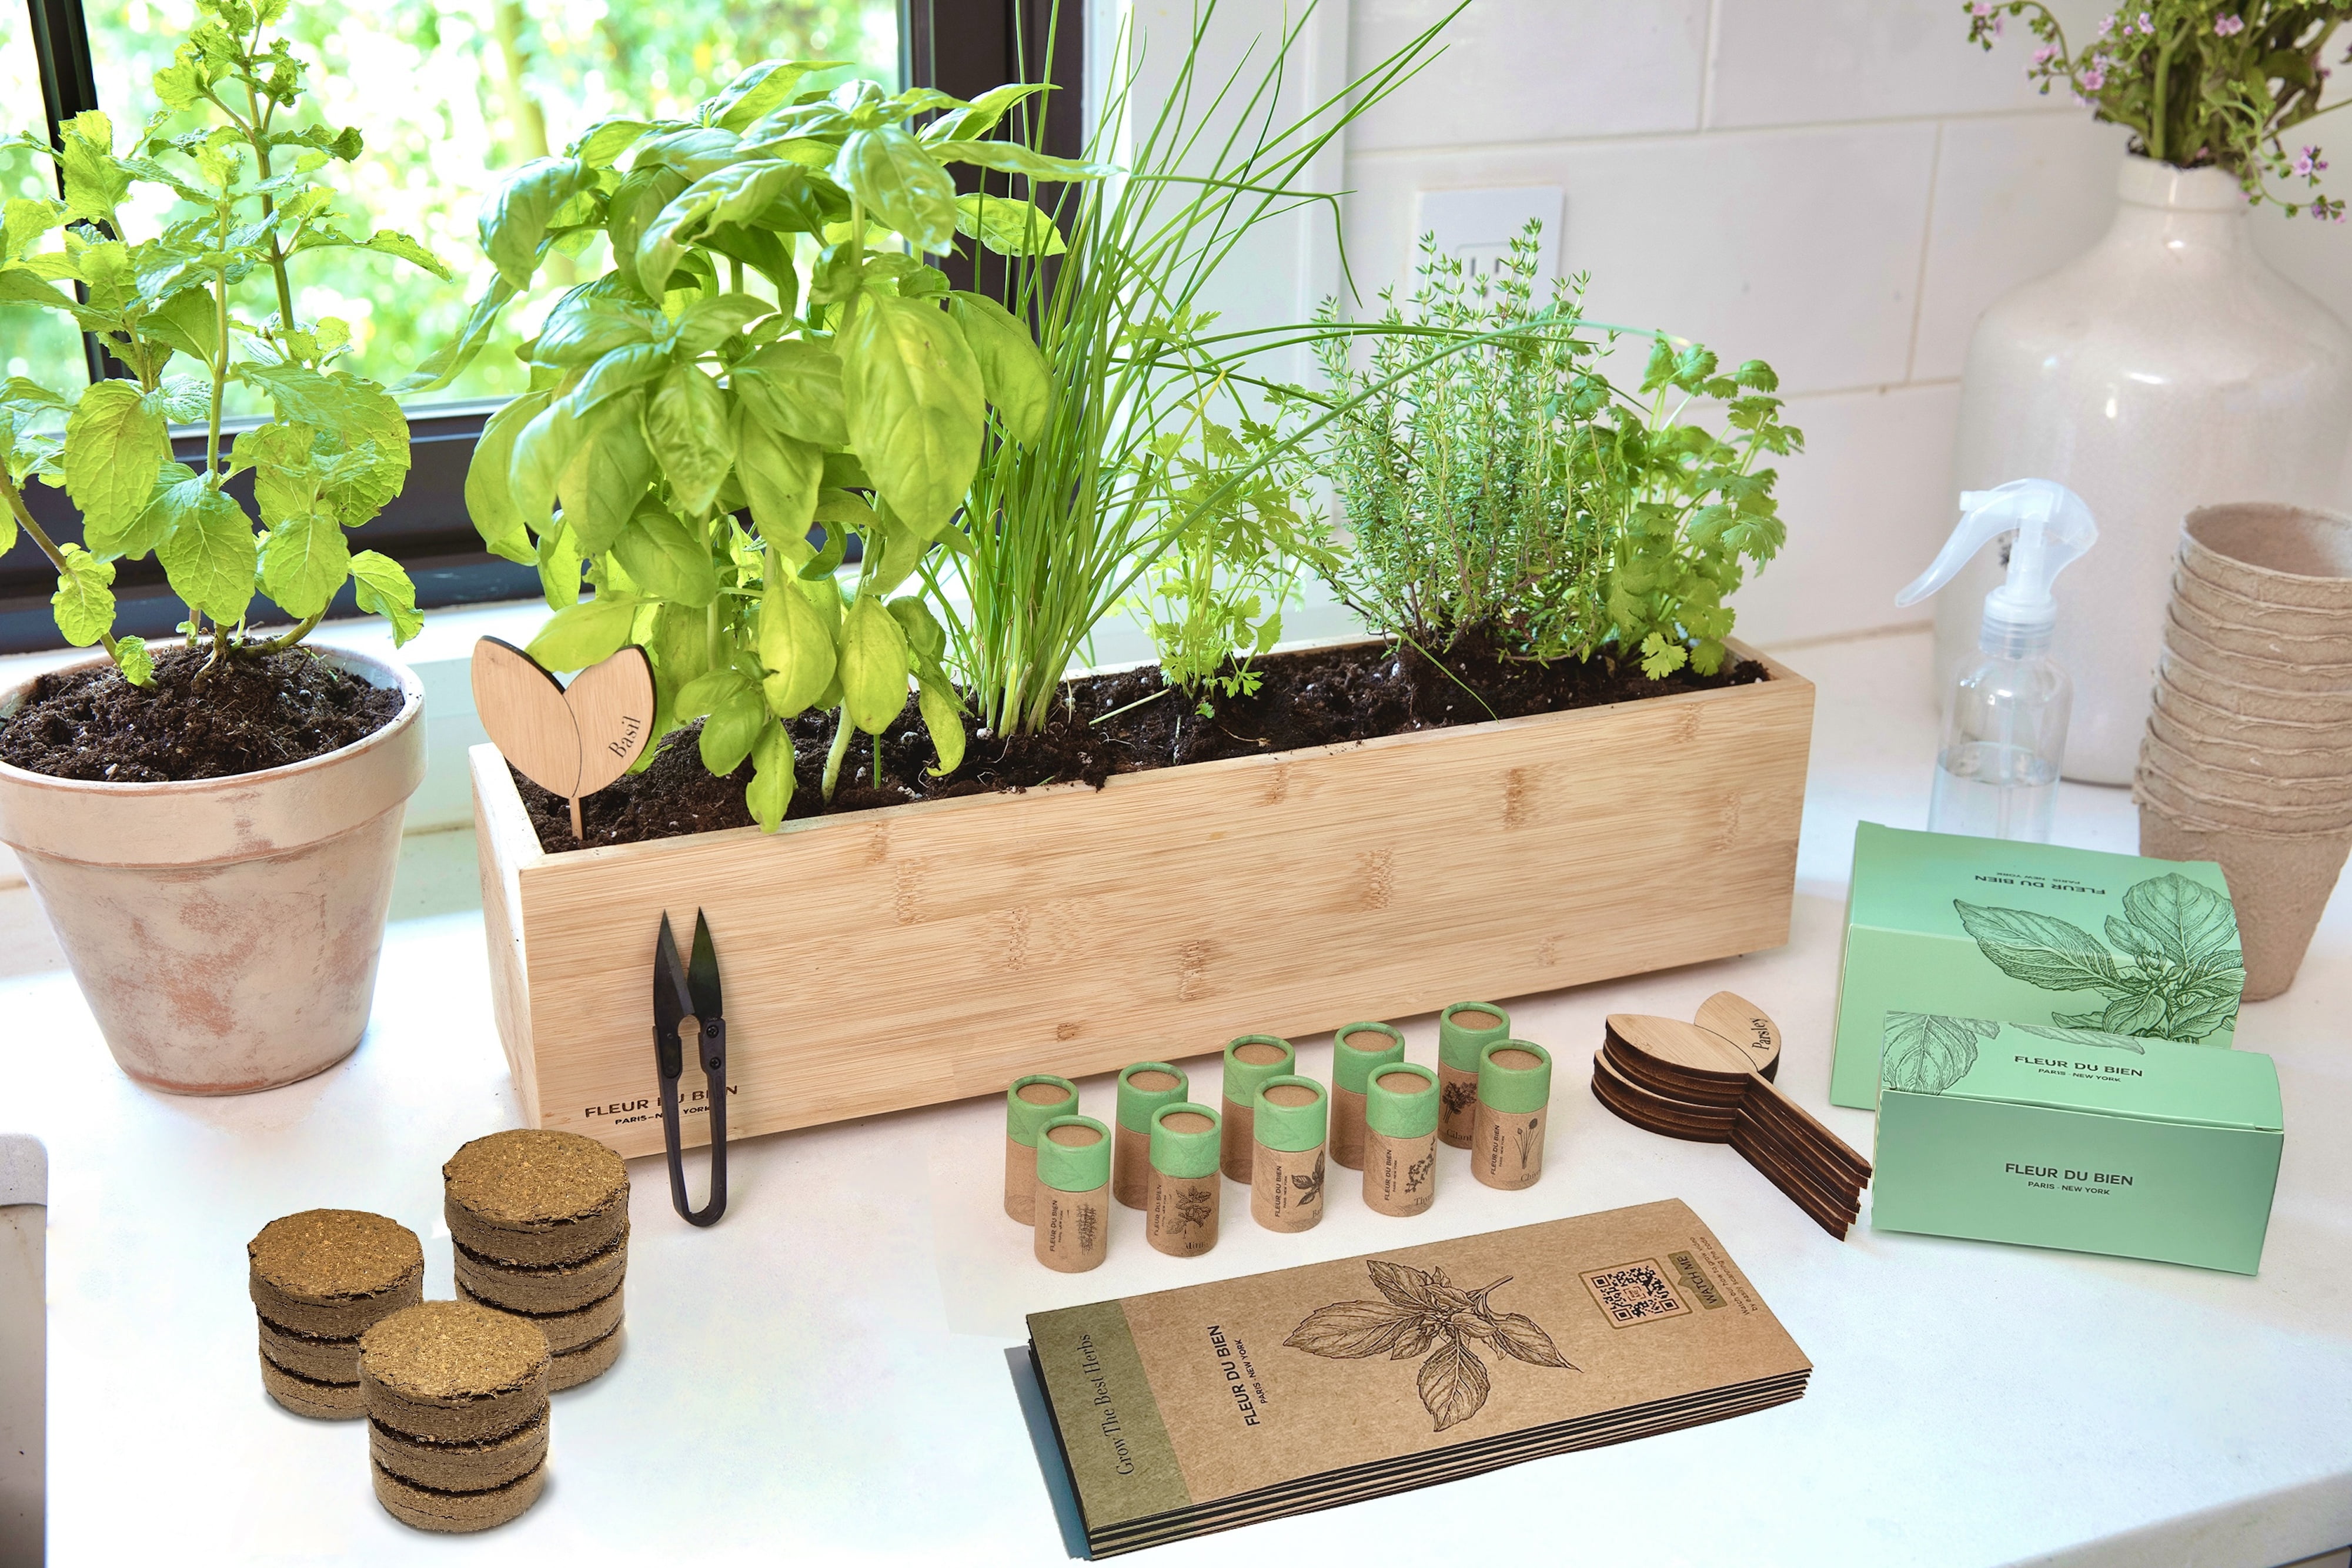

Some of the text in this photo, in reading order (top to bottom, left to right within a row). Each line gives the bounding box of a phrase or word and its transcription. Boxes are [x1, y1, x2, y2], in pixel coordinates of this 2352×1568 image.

[607, 716, 641, 758] Basil
[1975, 875, 2014, 884] BIEN
[2052, 884, 2106, 894] FLEUR
[1749, 1018, 1771, 1050] Parsley
[2014, 1055, 2143, 1076] FLEUR DU BIEN
[585, 1099, 649, 1118] FLEUR
[692, 1085, 737, 1101] BIN
[615, 1106, 710, 1125] PARIS-N YORK
[1446, 1128, 1472, 1141] Cilant
[1493, 1142, 1499, 1153] DU
[1385, 1167, 1391, 1178] DU
[2005, 1163, 2133, 1186] FLEUR DU BIEN
[1275, 1183, 1281, 1193] DU
[2028, 1181, 2055, 1189] PARIS
[1676, 1256, 1718, 1304] WATCH ME
[1718, 1261, 1739, 1285] scanning
[1734, 1297, 1750, 1316] Watch
[1234, 1339, 1248, 1360] YORK
[1207, 1325, 1261, 1426] FLEUR DU BIEN
[1243, 1361, 1256, 1378] NEW
[1253, 1382, 1268, 1404] PARIS
[1077, 1334, 1134, 1475] Grow The Best Herbs
